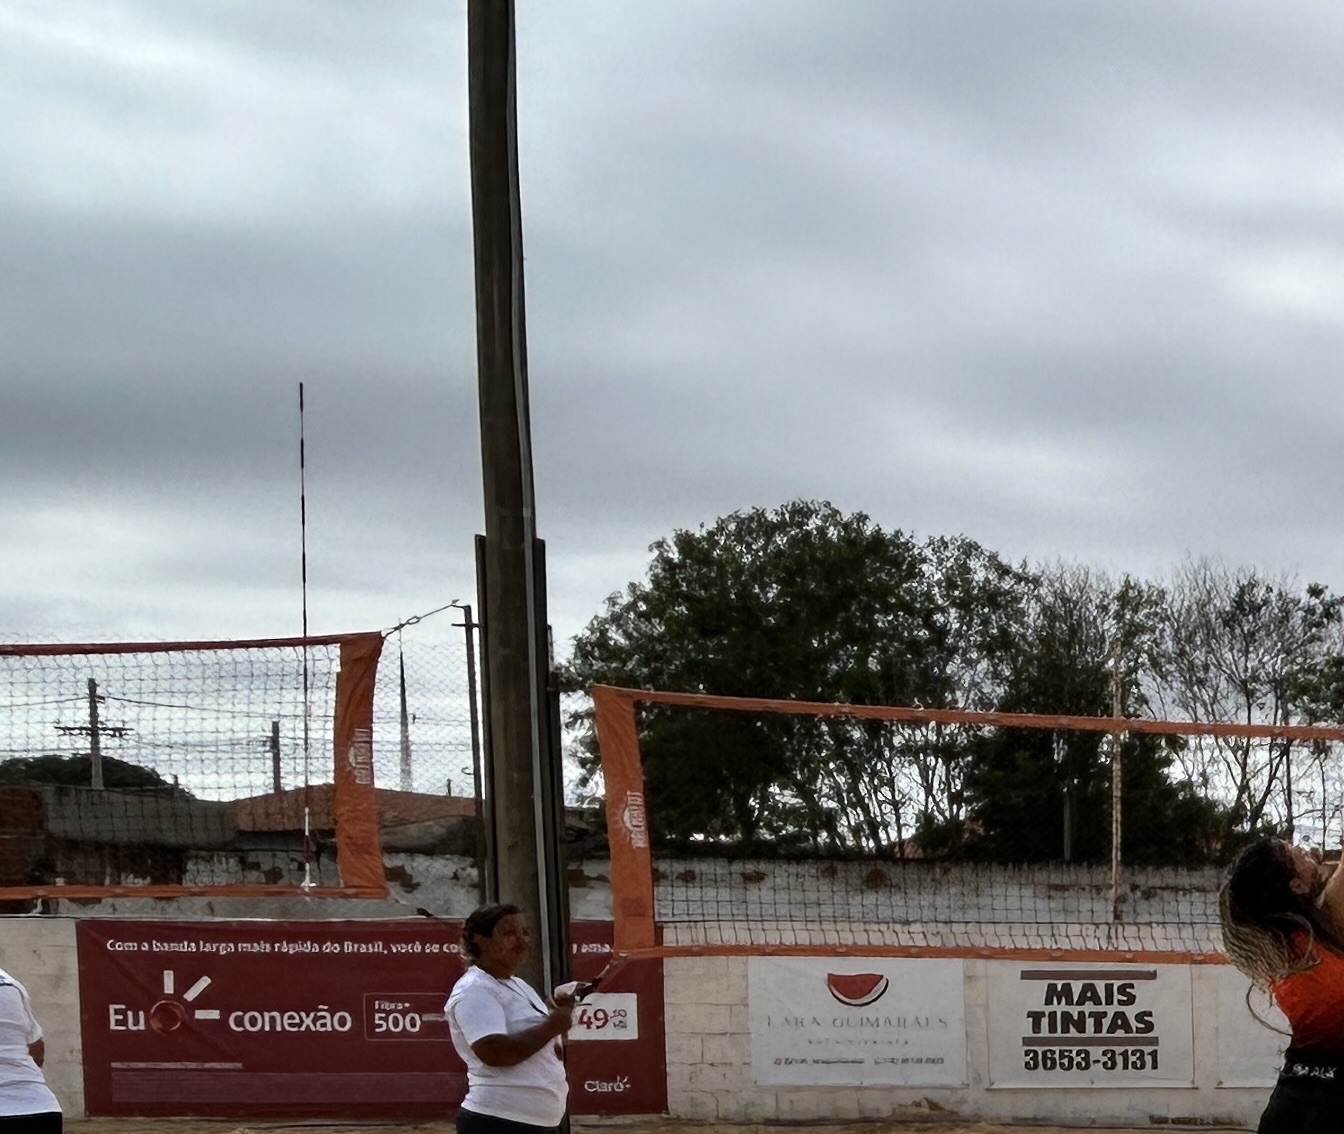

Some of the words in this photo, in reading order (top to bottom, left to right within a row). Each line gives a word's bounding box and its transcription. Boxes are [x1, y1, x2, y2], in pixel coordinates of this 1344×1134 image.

[106, 939, 138, 951] Com
[199, 940, 235, 955] larga
[344, 941, 388, 954] Brasil,
[1044, 983, 1136, 1006] MAIS
[109, 1004, 146, 1030] Eu
[228, 1005, 353, 1031] conexão
[375, 1013, 421, 1032] 500
[578, 1008, 610, 1030] 49
[1027, 1010, 1155, 1034] TINTAS
[1024, 1049, 1159, 1071] 3653-3131
[584, 1079, 625, 1092] Claro
